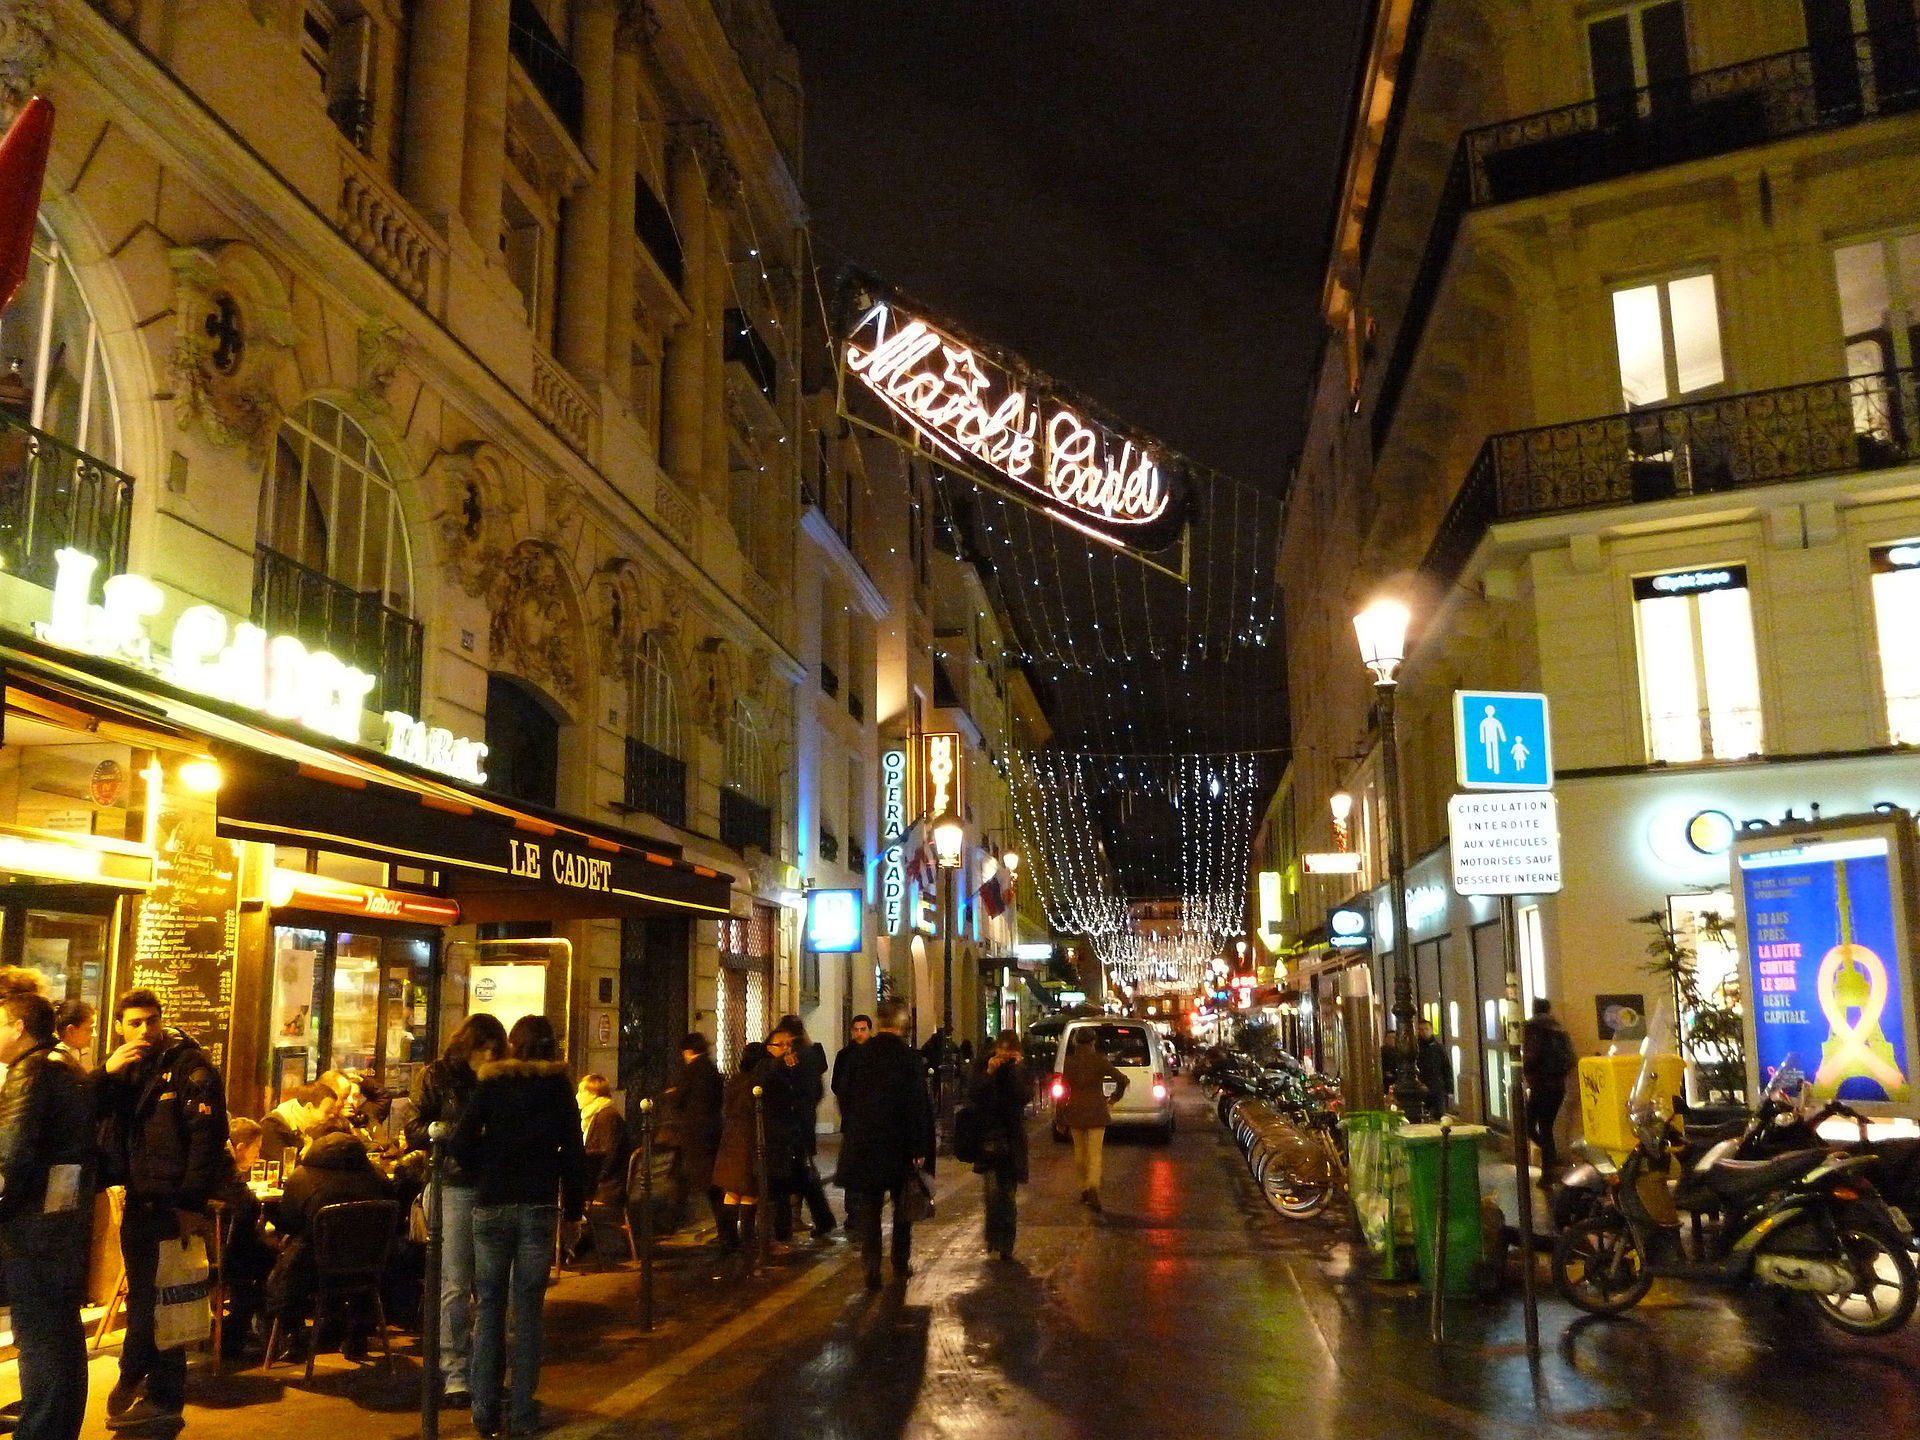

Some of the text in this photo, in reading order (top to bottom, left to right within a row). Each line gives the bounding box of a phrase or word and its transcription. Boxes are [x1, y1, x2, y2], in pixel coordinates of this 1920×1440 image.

[1048, 411, 1167, 520] Cadet
[1458, 802, 1548, 814] CIRCULATION
[1468, 819, 1540, 831] INTERDITE
[884, 752, 904, 933] OPERA CADET
[1463, 840, 1484, 849] AUX
[509, 839, 613, 893] LE CADET
[1460, 855, 1553, 867] MOTORISÉS SAUF
[1456, 872, 1560, 885] DESSERTE INTERNE
[364, 891, 403, 916] Tabac
[1758, 942, 1802, 958] LA LUTTE
[1761, 976, 1798, 992] LE SIDA
[1763, 993, 1791, 1008] RESTE
